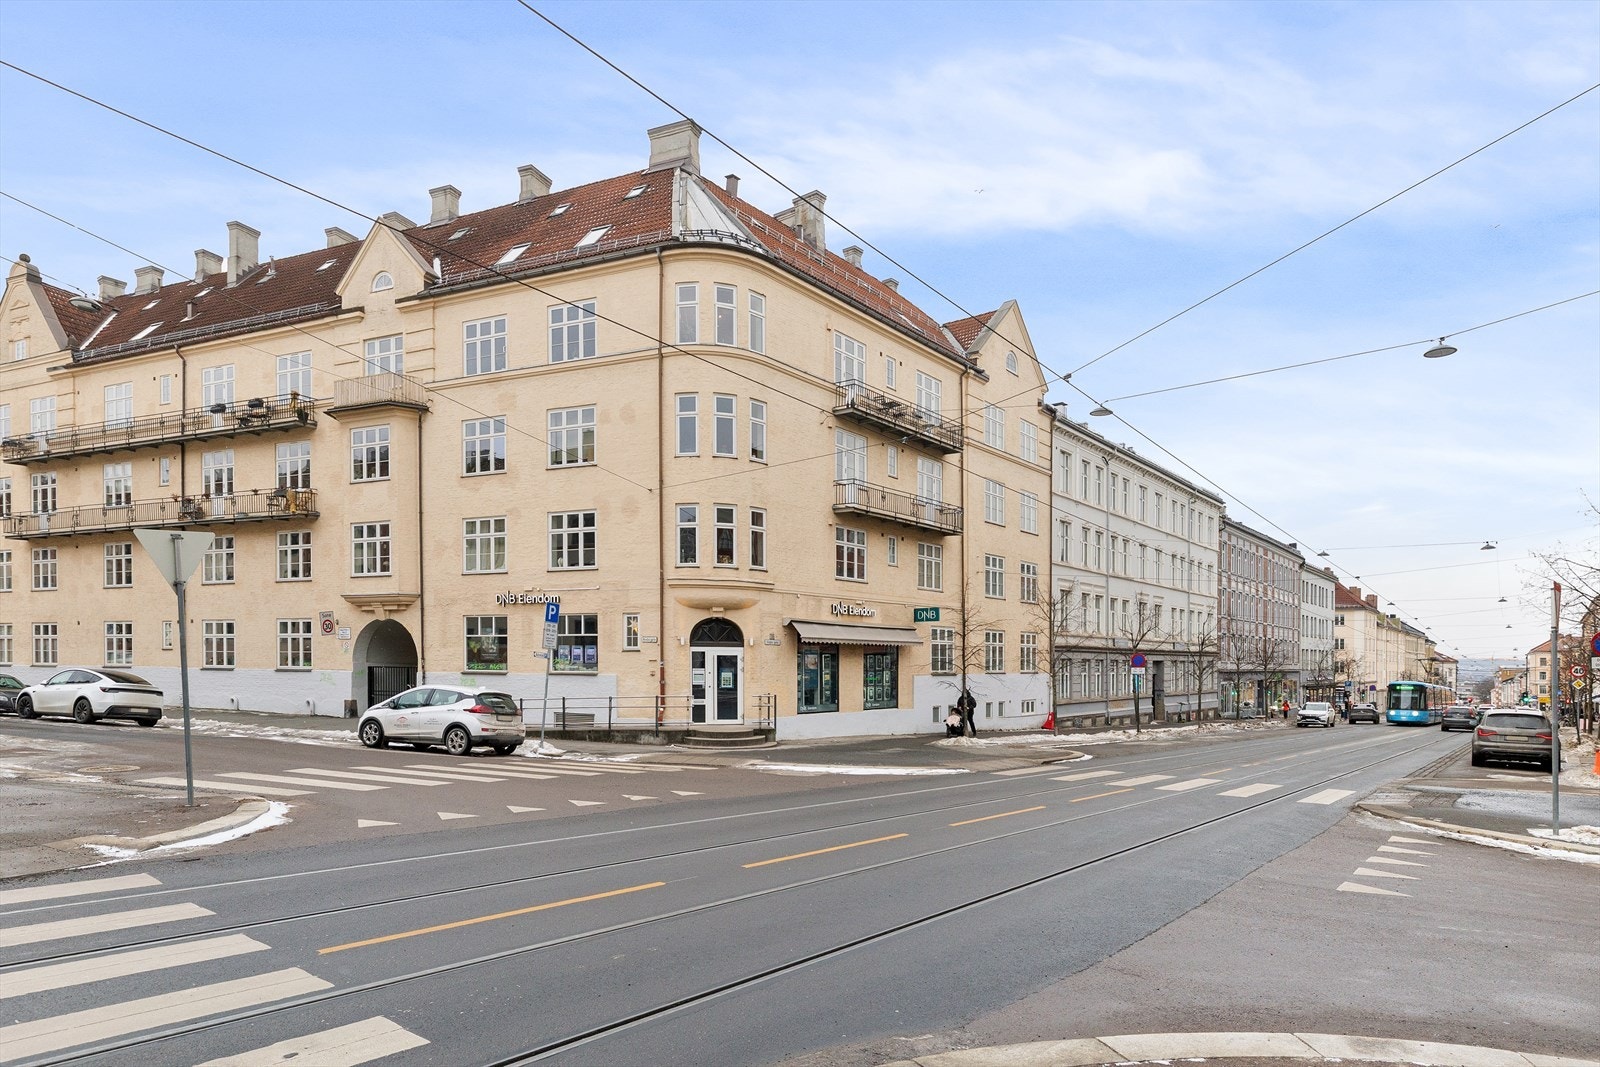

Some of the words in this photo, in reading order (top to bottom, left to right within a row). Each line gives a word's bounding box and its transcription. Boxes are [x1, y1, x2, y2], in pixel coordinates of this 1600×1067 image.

[495, 590, 516, 607] DNB
[518, 593, 560, 604] Eiendom
[548, 605, 557, 620] P
[831, 601, 848, 617] DNB
[849, 604, 877, 617] Eiendom
[917, 608, 937, 621] DNB
